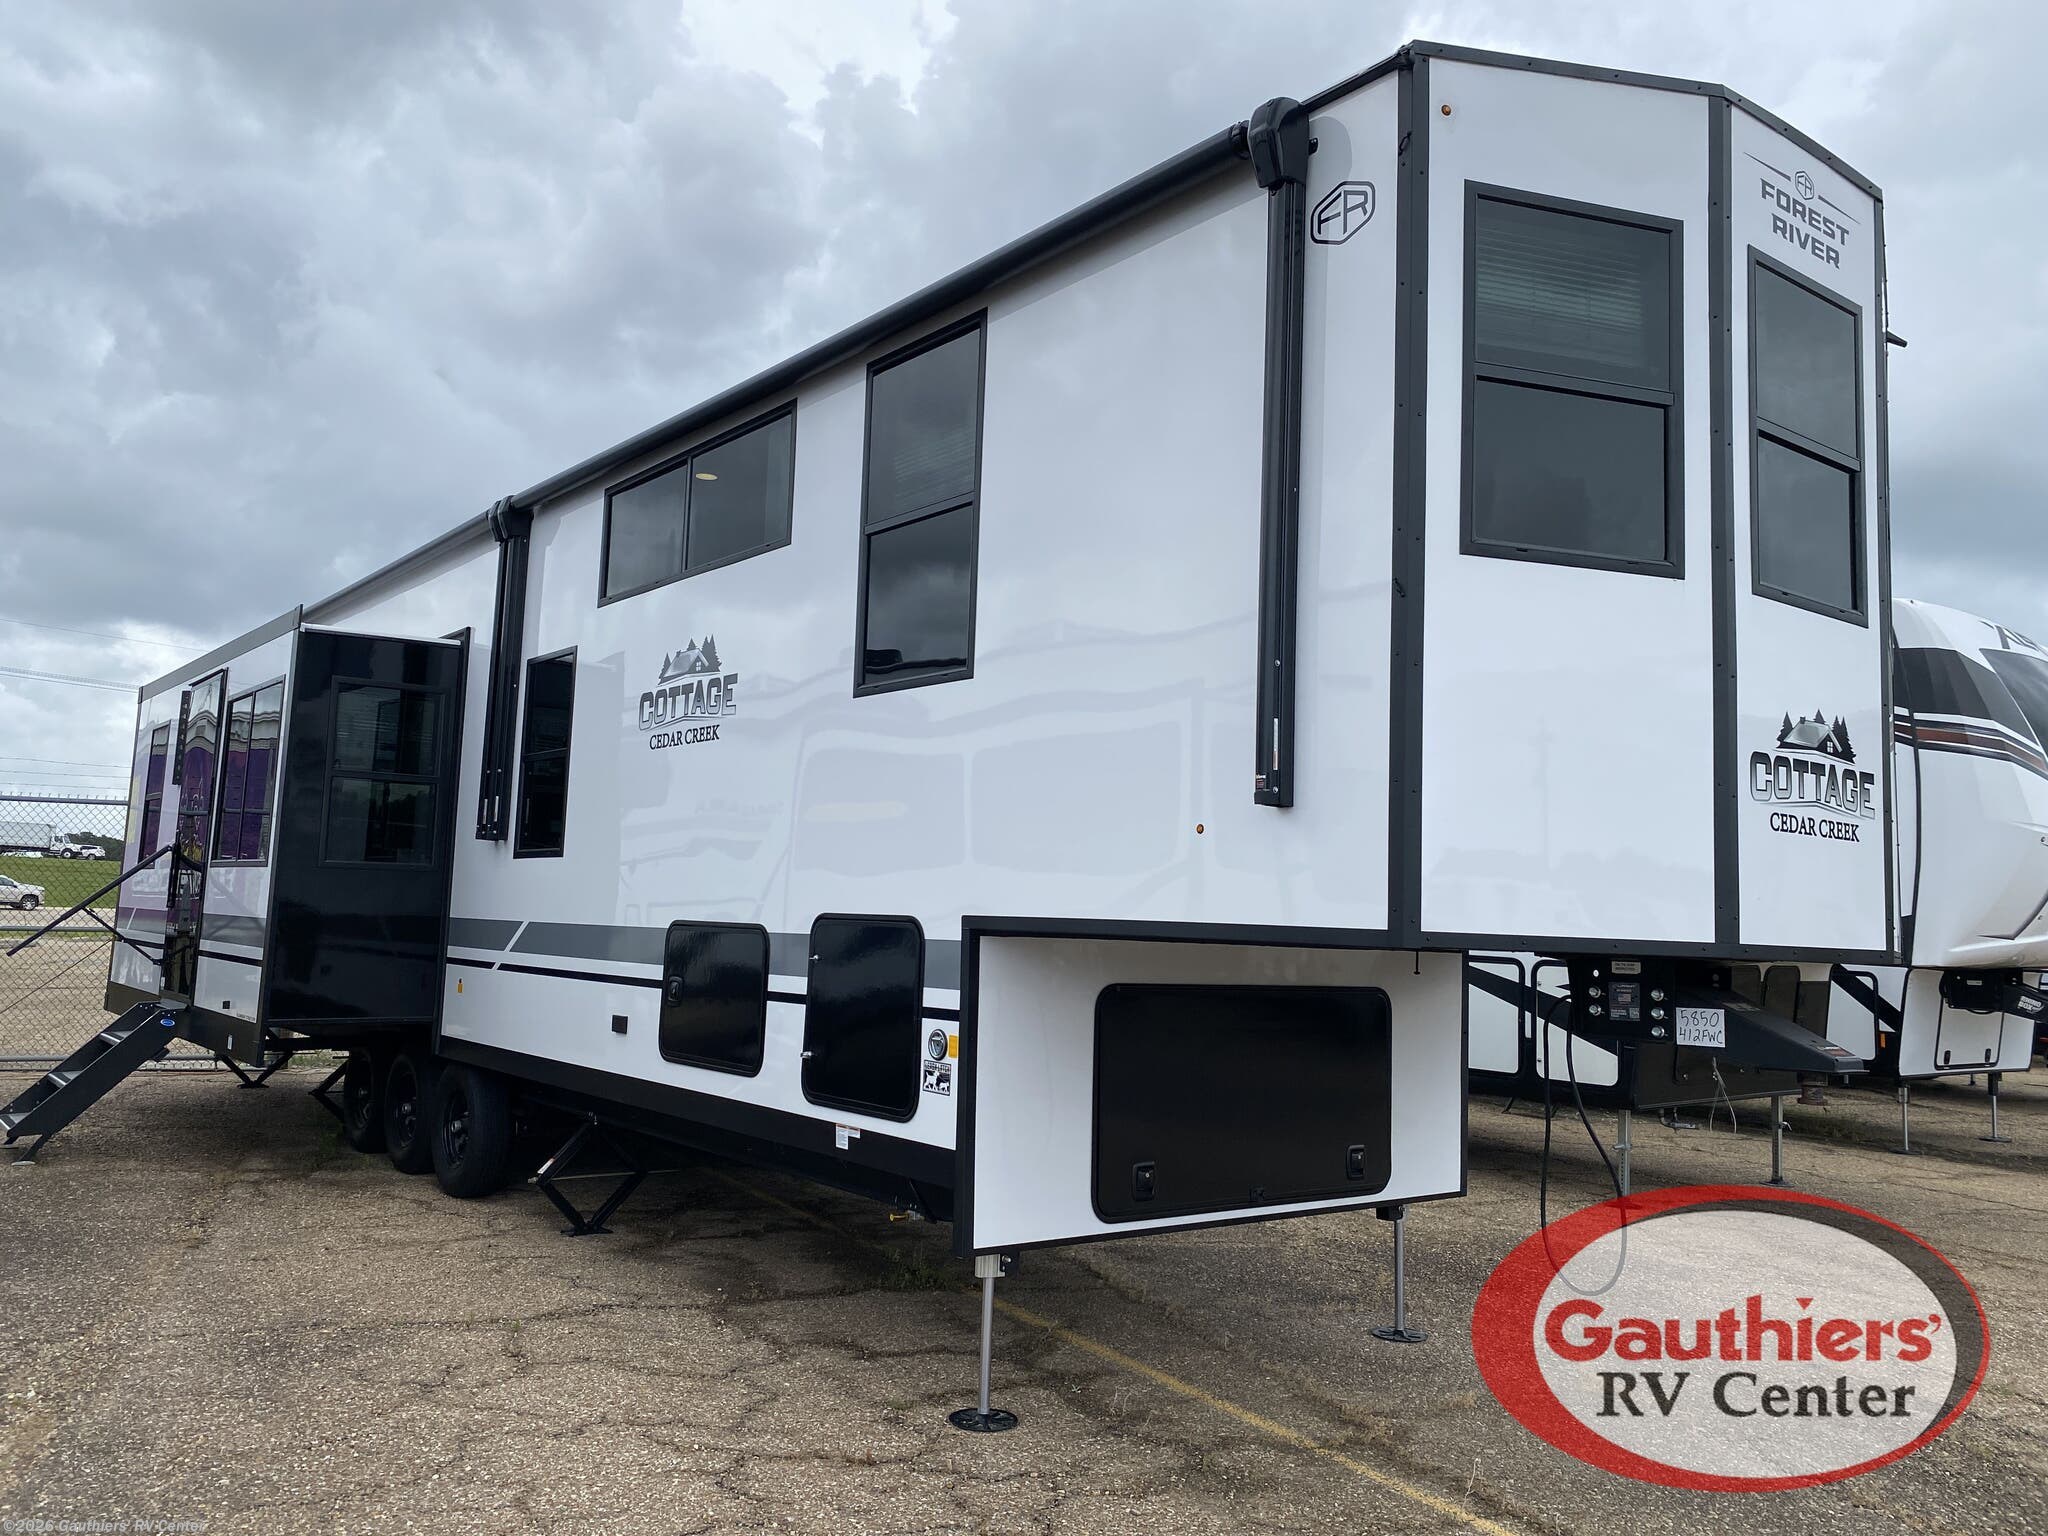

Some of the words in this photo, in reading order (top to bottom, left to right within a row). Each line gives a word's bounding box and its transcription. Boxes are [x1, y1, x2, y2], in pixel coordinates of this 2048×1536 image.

[1760, 178, 1849, 246] FOREST
[1772, 213, 1840, 269] RIVER
[639, 673, 738, 731] COTTAGE
[649, 731, 683, 750] CEDAR
[684, 724, 720, 744] CREEK
[1750, 751, 1875, 820] COTTAGE
[1770, 812, 1817, 837] CEDAR
[1818, 819, 1860, 842] CREEK
[1678, 1026, 1724, 1045] 412FWC
[1679, 1009, 1720, 1028] 5850
